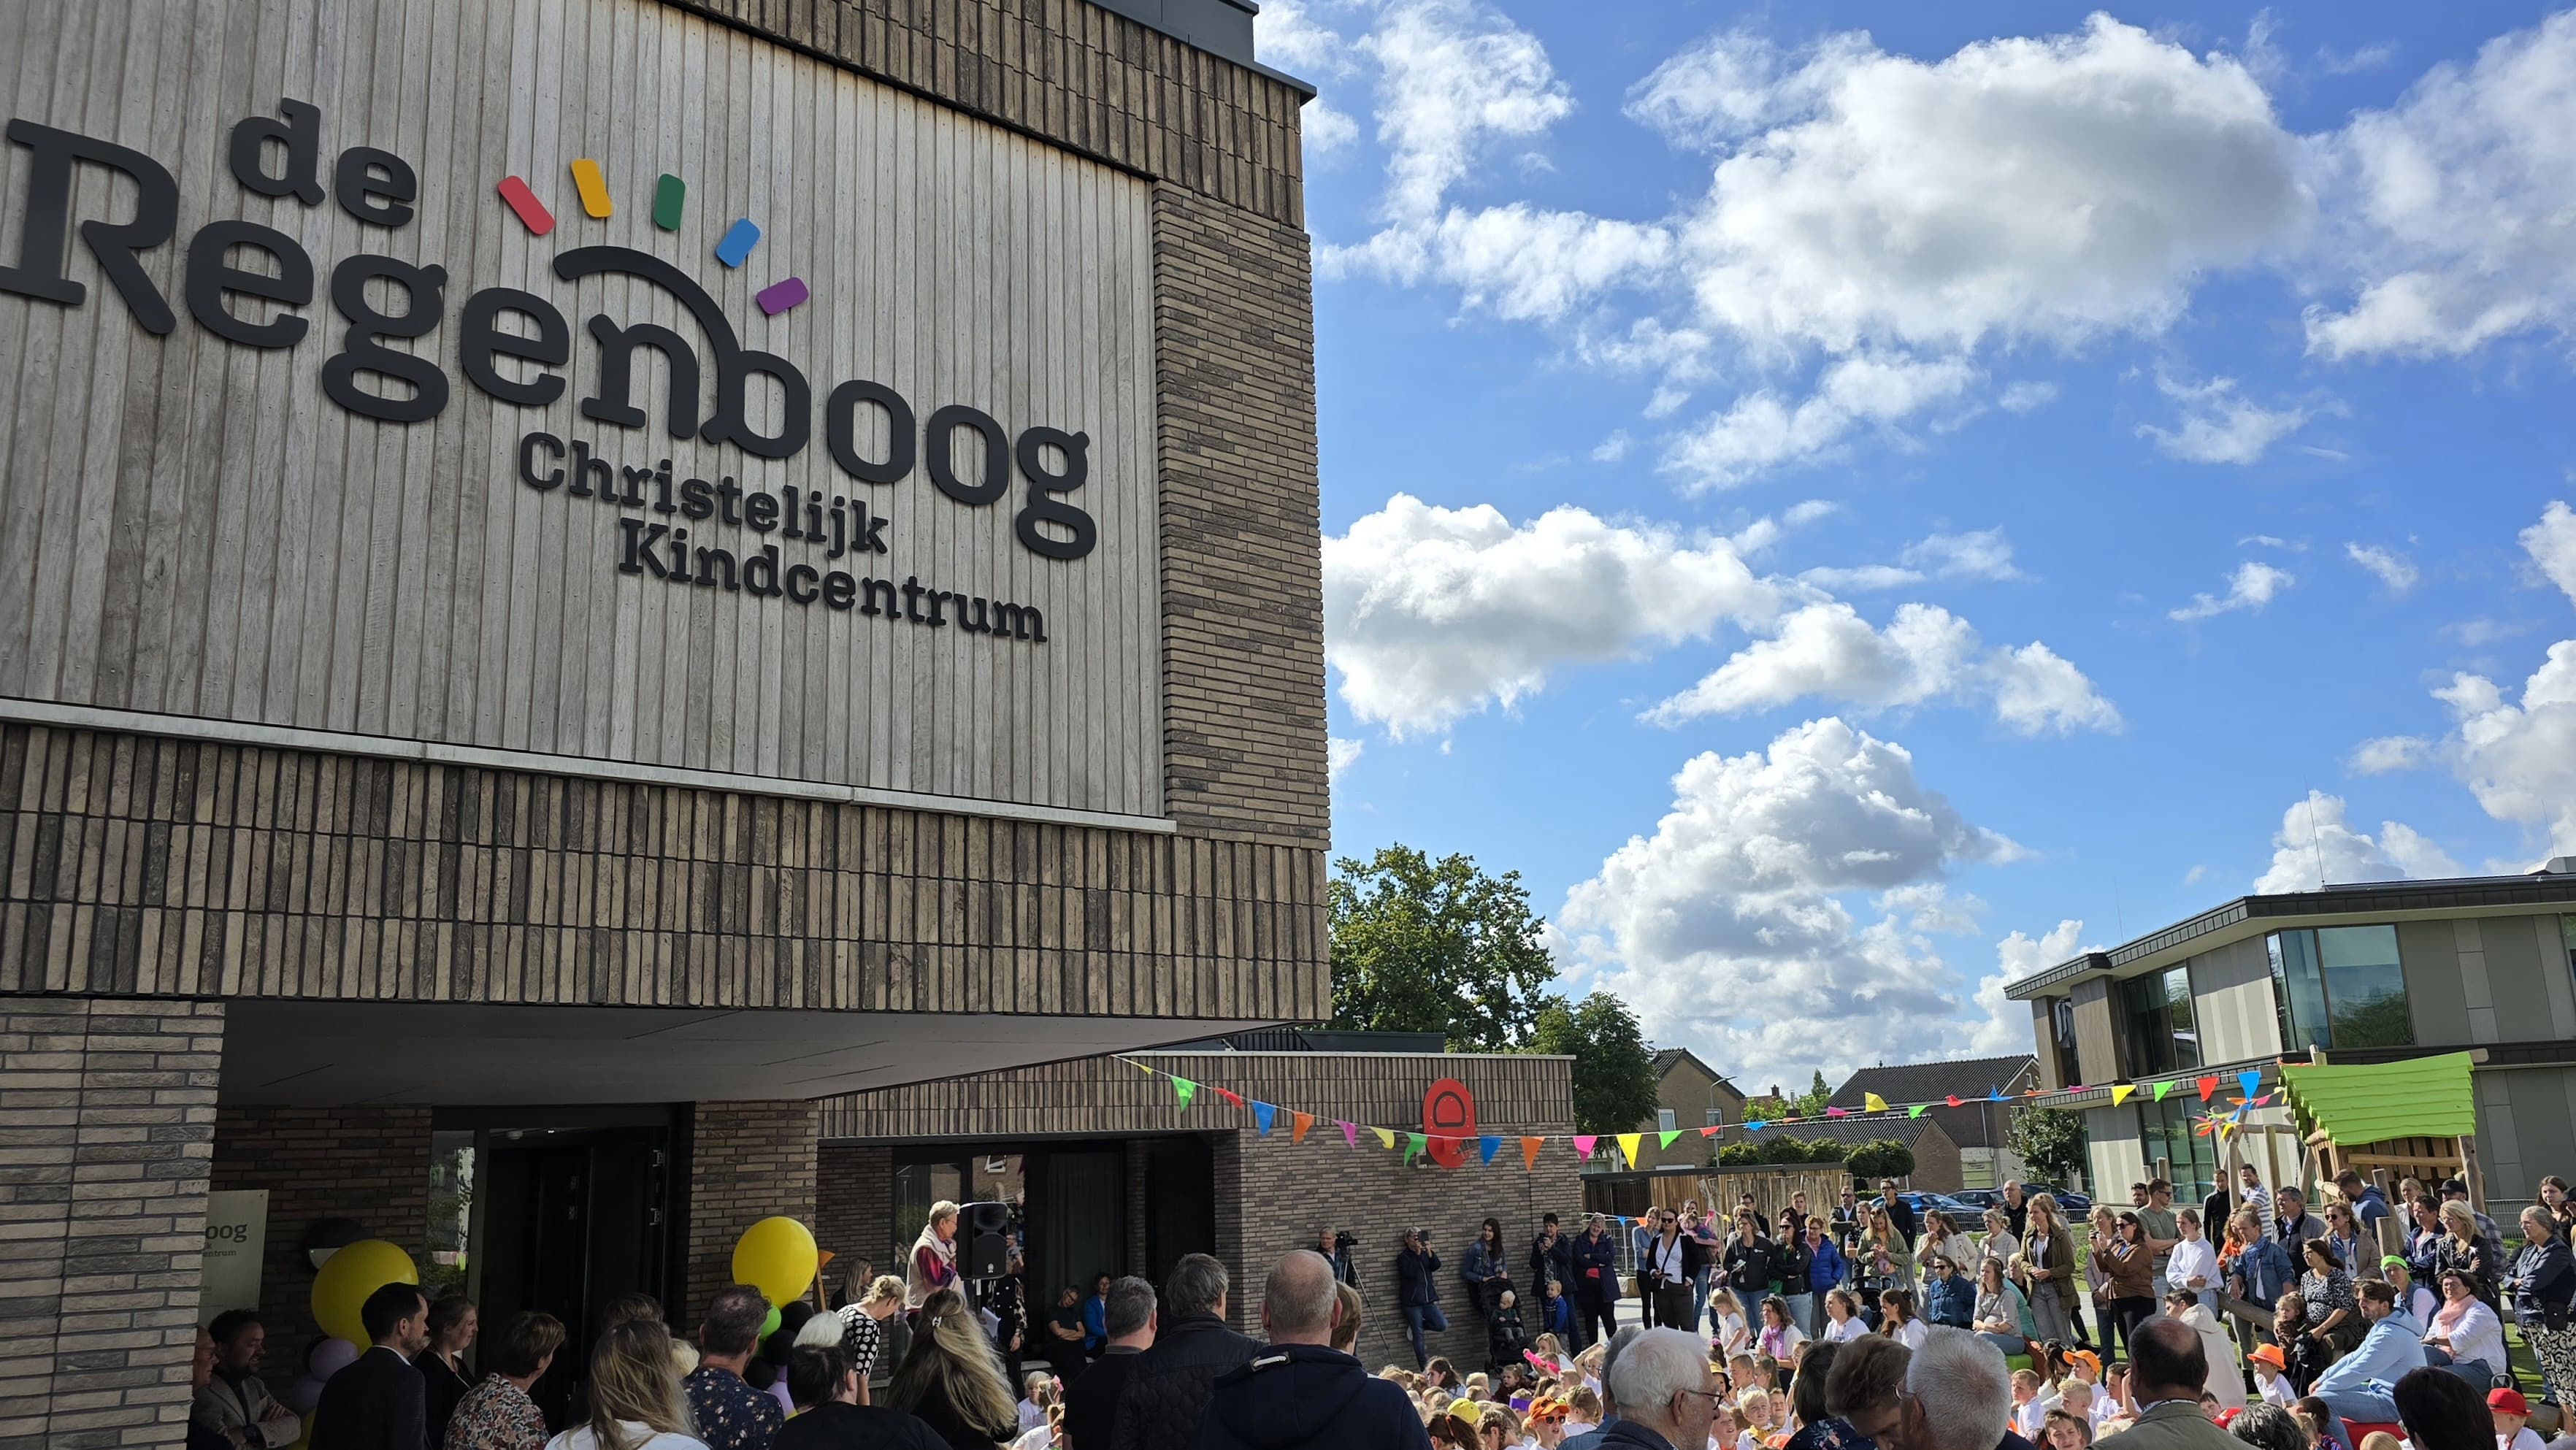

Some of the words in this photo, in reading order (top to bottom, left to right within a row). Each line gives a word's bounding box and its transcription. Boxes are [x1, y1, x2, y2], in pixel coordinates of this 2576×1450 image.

[229, 97, 417, 227] de
[0, 118, 1097, 560] Regenboog
[520, 431, 889, 559] Christelijk
[618, 517, 1048, 643] Kindcentrum
